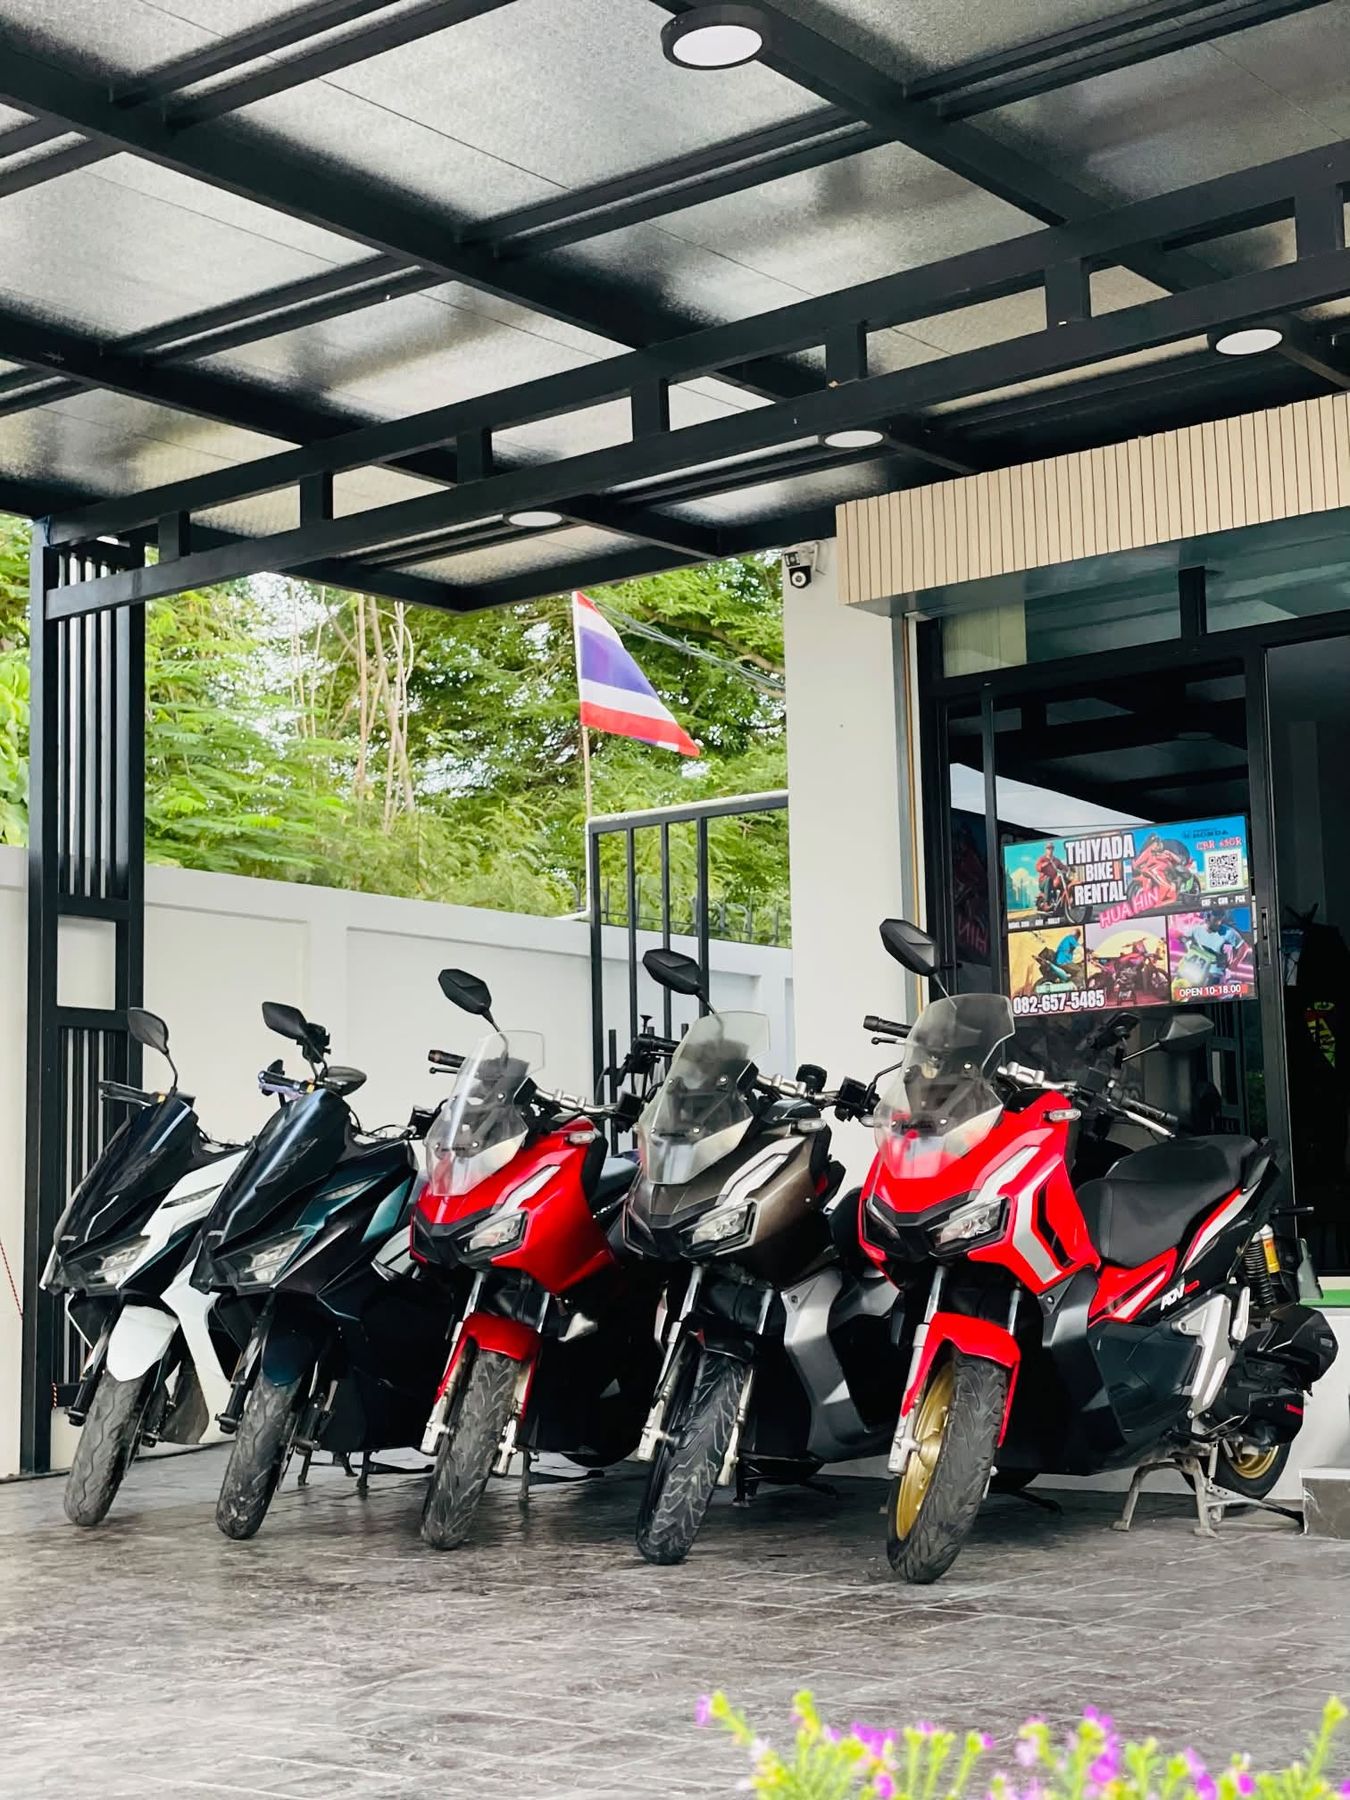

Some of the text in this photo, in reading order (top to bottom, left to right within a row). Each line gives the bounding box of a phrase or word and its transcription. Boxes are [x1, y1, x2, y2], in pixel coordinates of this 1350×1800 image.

[1065, 834, 1135, 865] THIYADA
[1085, 861, 1114, 882] BIKE
[1074, 881, 1128, 906] RENTAL
[1099, 886, 1160, 928] HUA HIN
[1013, 989, 1105, 1014] 082-657-5485
[1179, 987, 1203, 998] OPEN
